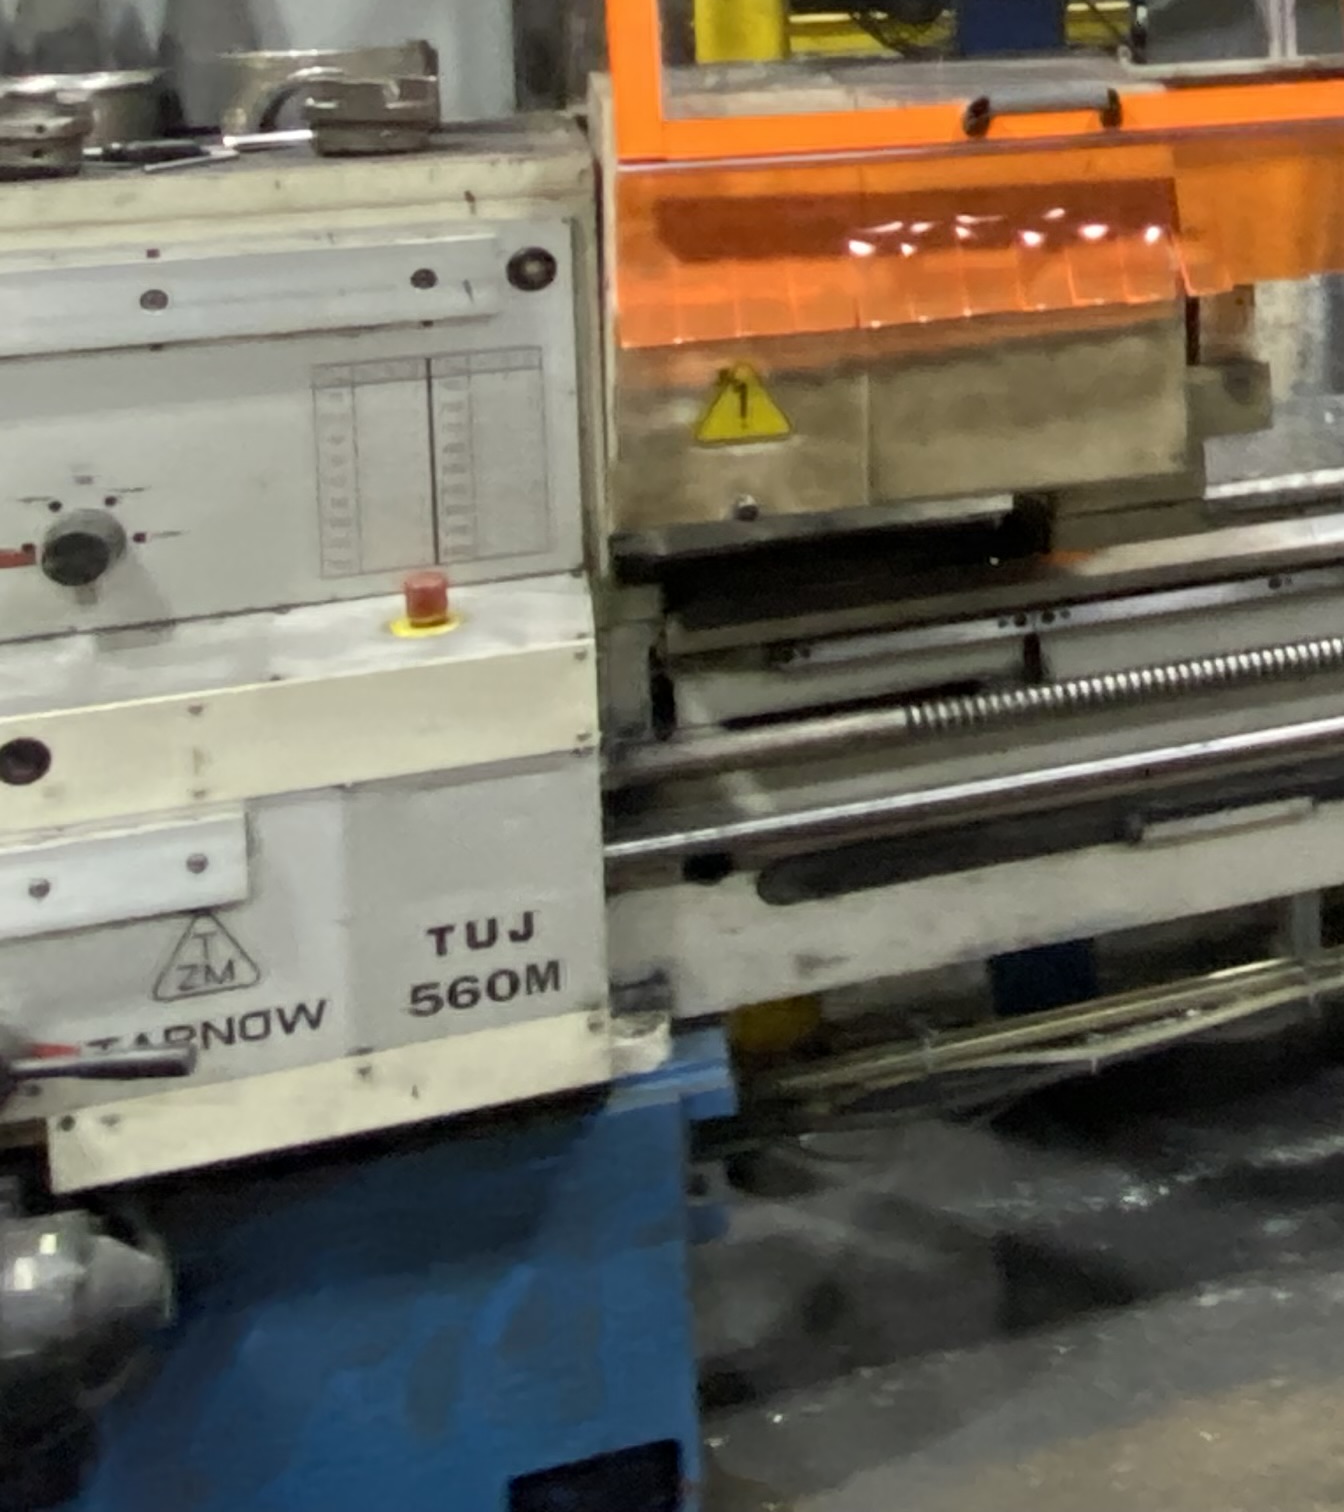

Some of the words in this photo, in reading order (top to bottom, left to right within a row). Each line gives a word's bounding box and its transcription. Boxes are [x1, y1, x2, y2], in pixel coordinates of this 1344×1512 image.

[191, 930, 218, 961] T
[426, 911, 534, 957] TUJ
[177, 959, 236, 992] ZM
[408, 959, 561, 1017] 560M
